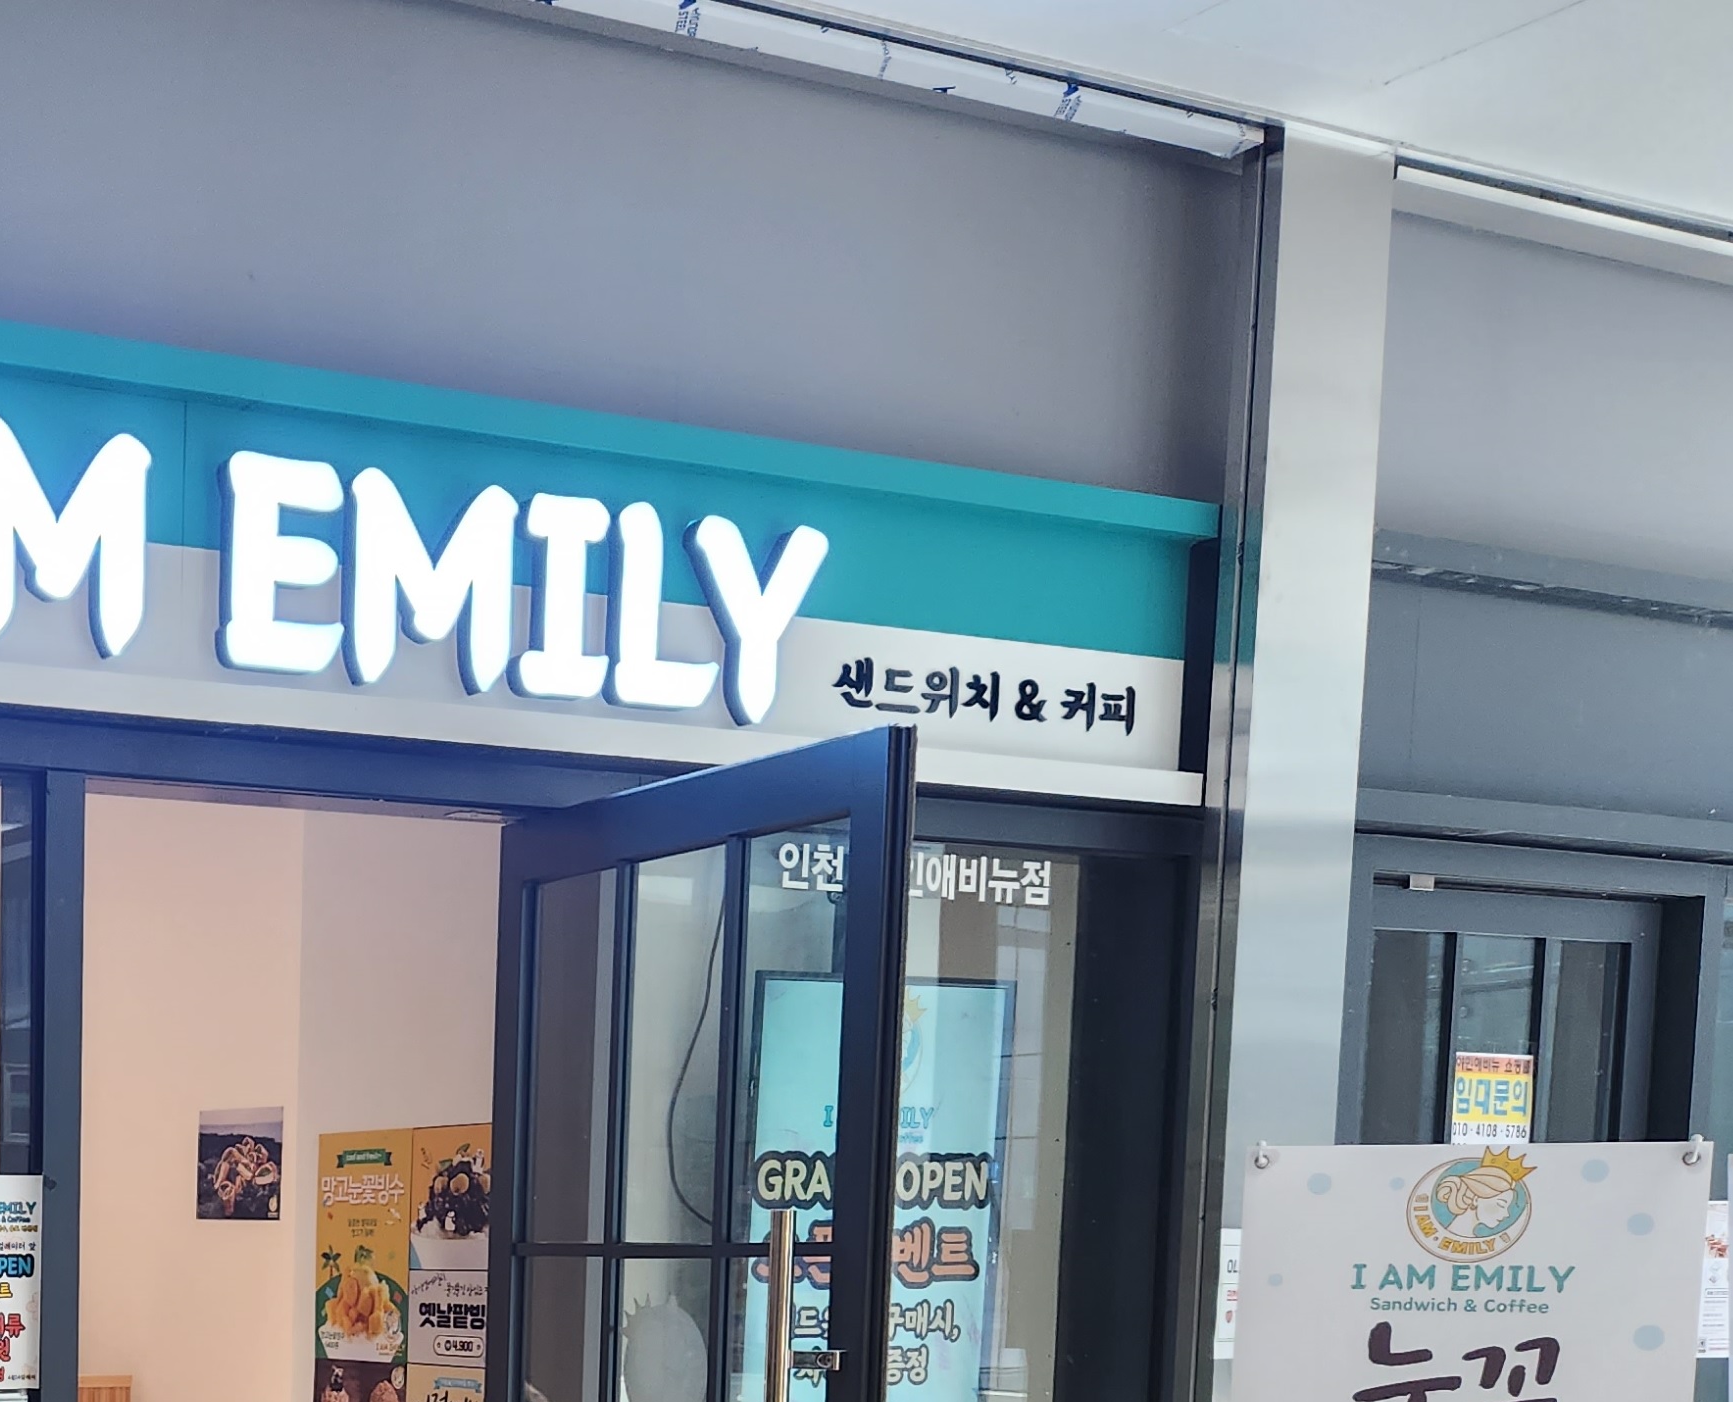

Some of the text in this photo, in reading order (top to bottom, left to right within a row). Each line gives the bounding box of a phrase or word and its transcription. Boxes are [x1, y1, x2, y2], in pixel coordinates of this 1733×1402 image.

[216, 449, 829, 727] EMILY
[831, 656, 1136, 736] 샌드위치 & 커피
[778, 842, 845, 894] 인천
[1456, 1076, 1529, 1117] 임대문의
[321, 1172, 405, 1206] 망고눈꽃빙수
[756, 1158, 989, 1202] GRA OPEN
[1414, 1214, 1438, 1239] AM
[1437, 1236, 1496, 1255] EMILY
[1350, 1263, 1576, 1294] I AM EMILY
[418, 1302, 486, 1330] 옛날팥빙
[1370, 1297, 1550, 1314] Sandwich & Coffee
